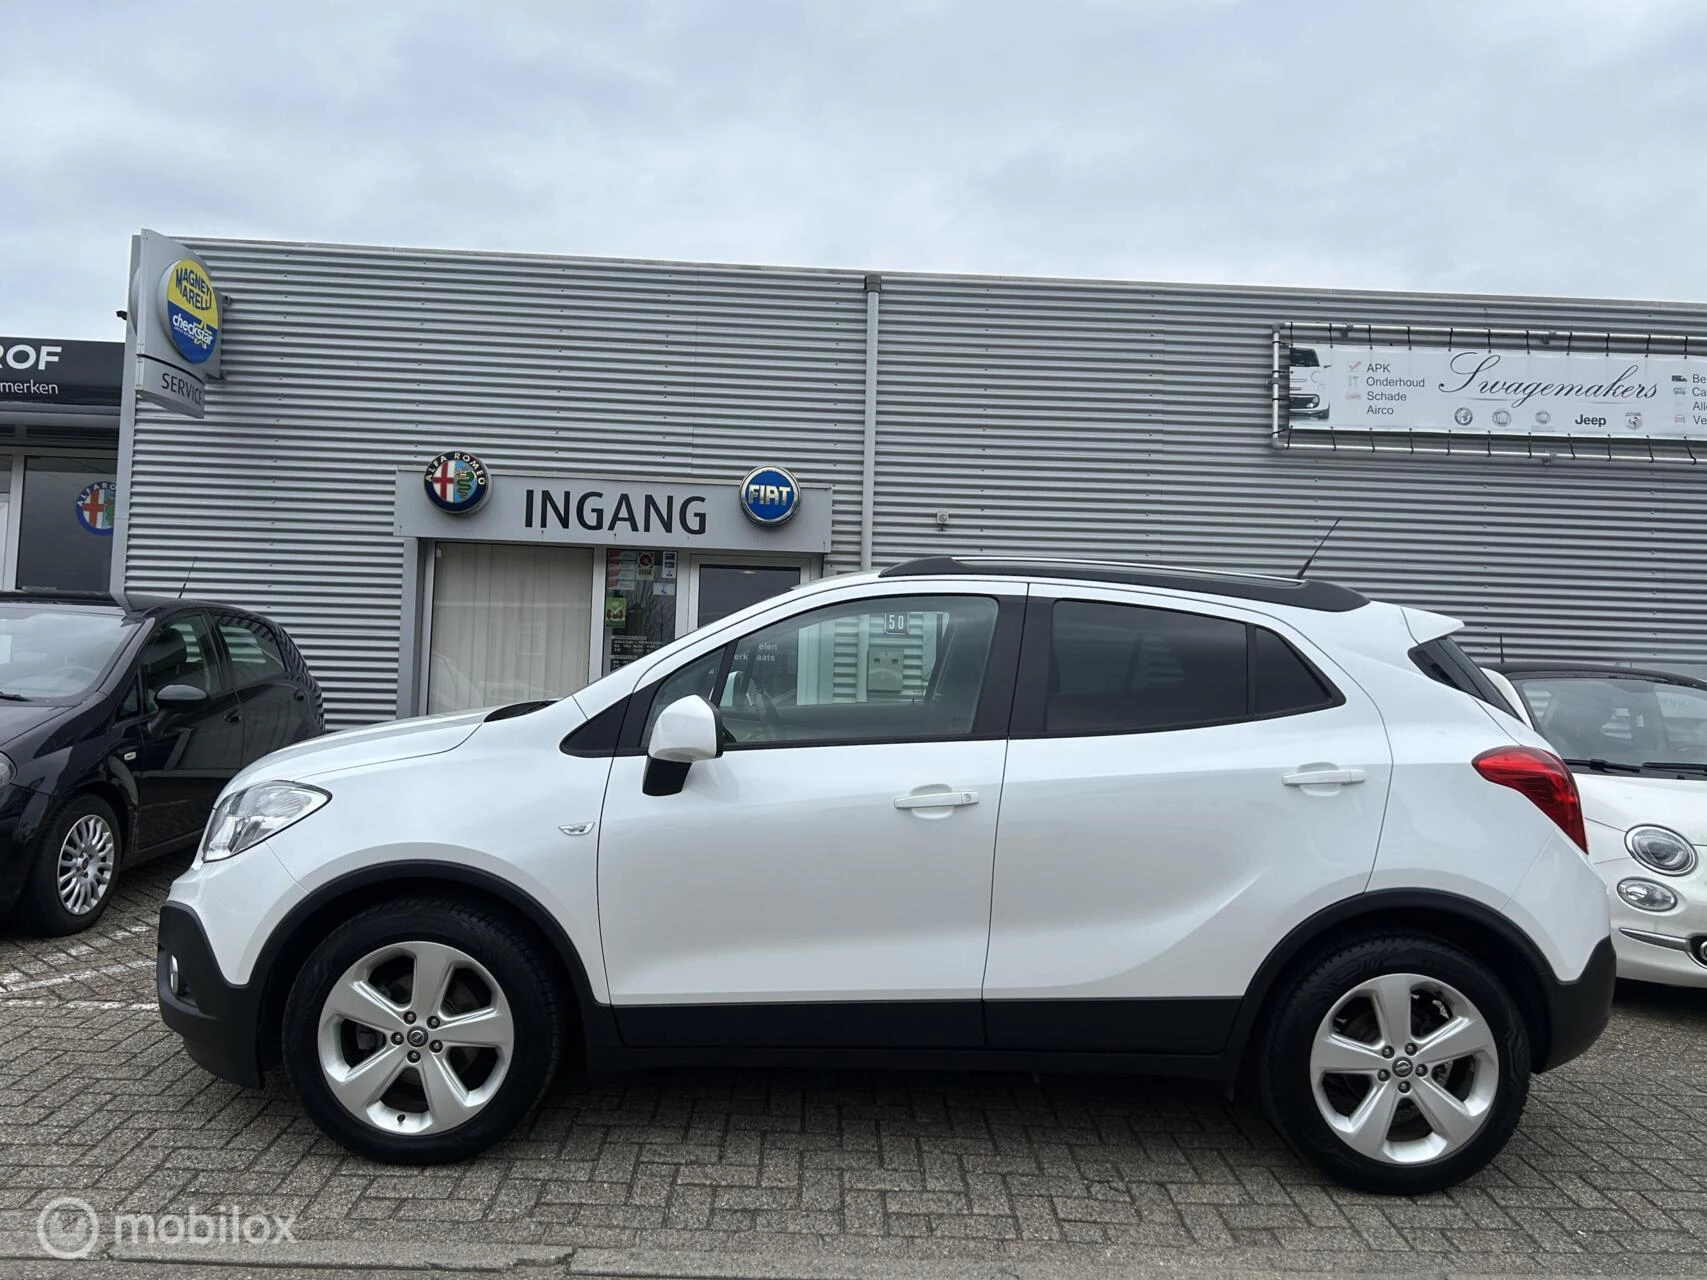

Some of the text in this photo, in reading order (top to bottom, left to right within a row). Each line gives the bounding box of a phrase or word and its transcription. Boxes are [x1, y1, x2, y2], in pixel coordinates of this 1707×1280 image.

[175, 267, 212, 296] MAGNETI
[177, 284, 212, 311] MARELLI
[172, 312, 214, 345] checkstar
[0, 344, 62, 370] OF
[1366, 363, 1391, 373] APK
[1366, 376, 1425, 388] Onderhoud
[1438, 351, 1658, 408] Swagemakers
[1366, 391, 1407, 401] Schade
[1692, 401, 1707, 411] All
[1366, 405, 1394, 415] Airco
[1575, 414, 1607, 427] Jeep
[425, 452, 486, 485] ALFA ROMEO
[749, 483, 791, 506] FIAT
[524, 489, 707, 536] INGANG
[889, 614, 904, 630] 50
